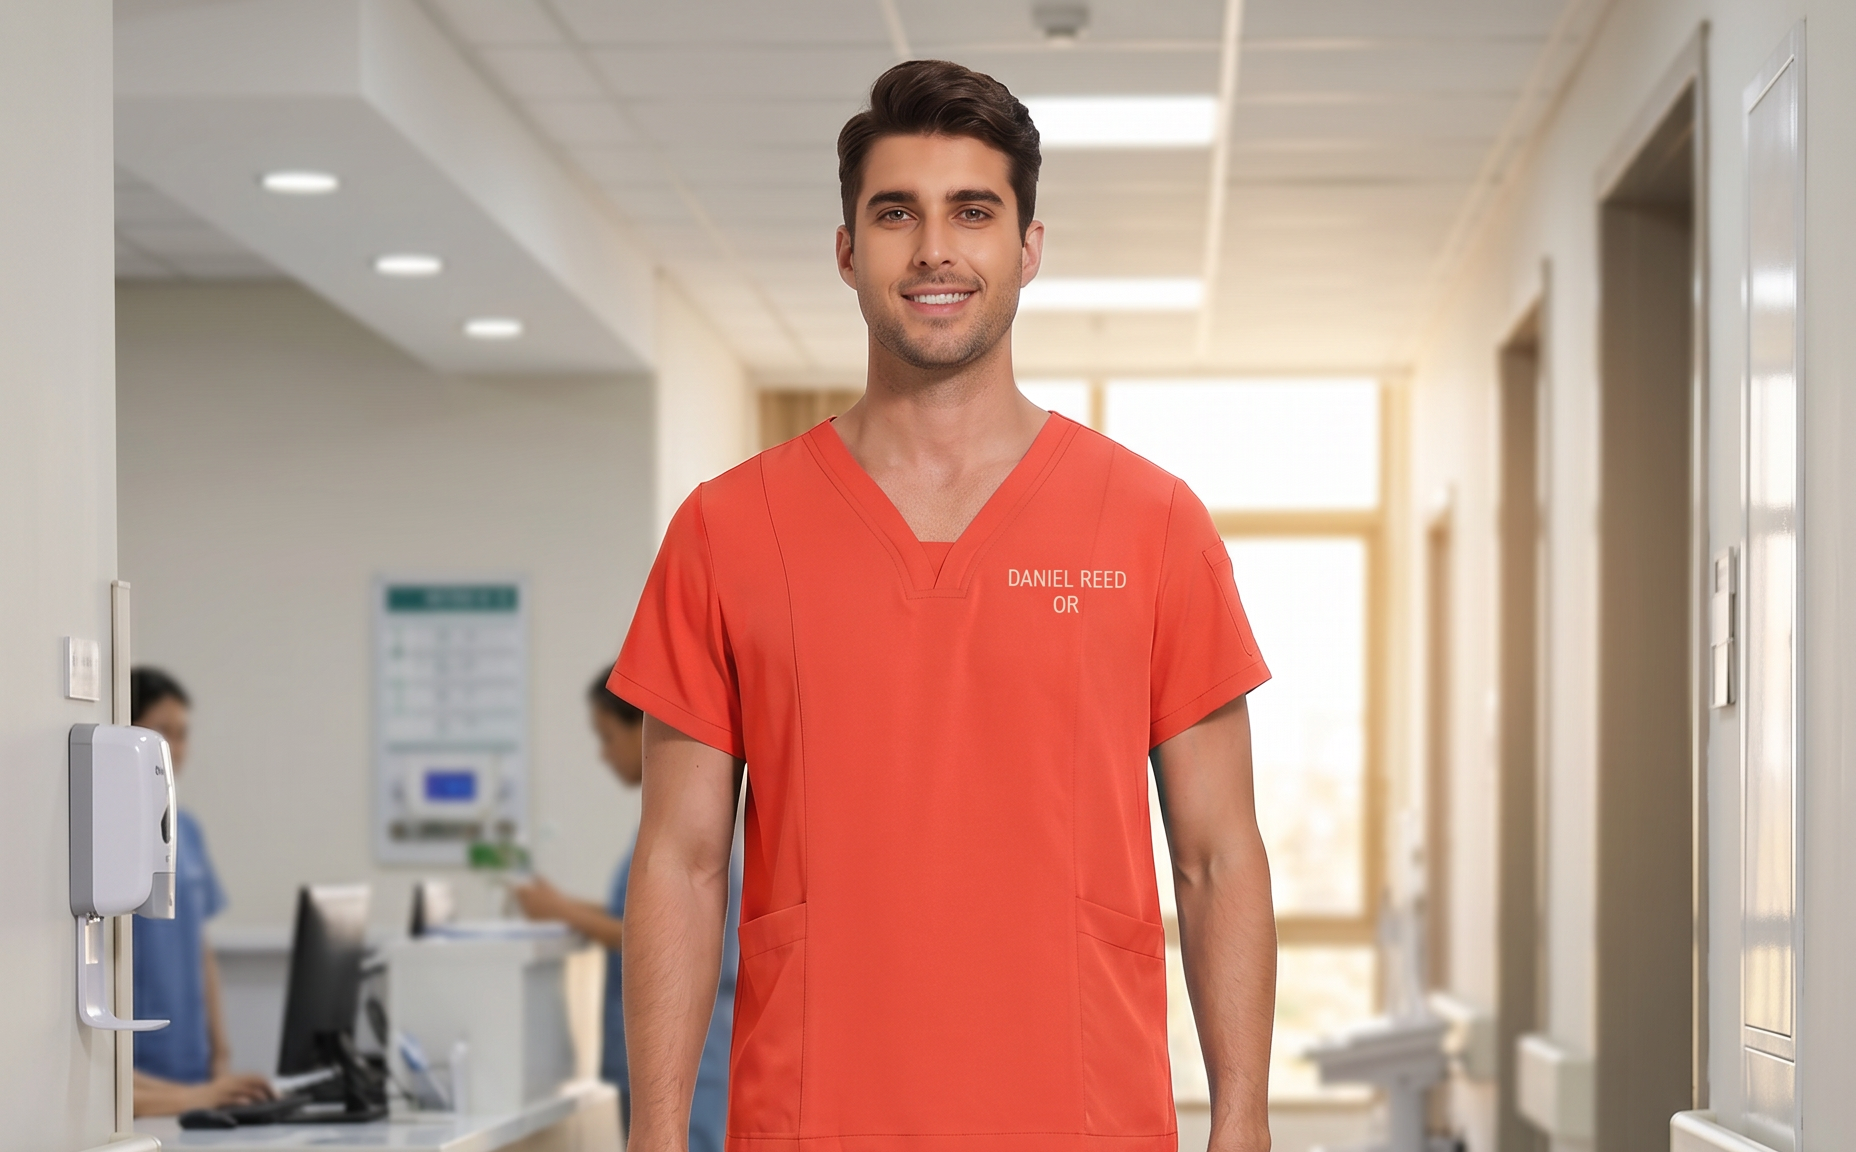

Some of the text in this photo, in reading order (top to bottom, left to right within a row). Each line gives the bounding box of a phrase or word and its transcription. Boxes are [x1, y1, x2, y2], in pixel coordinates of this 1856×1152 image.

[1008, 568, 1127, 589] DANIEL REED
[1053, 595, 1079, 614] OR
